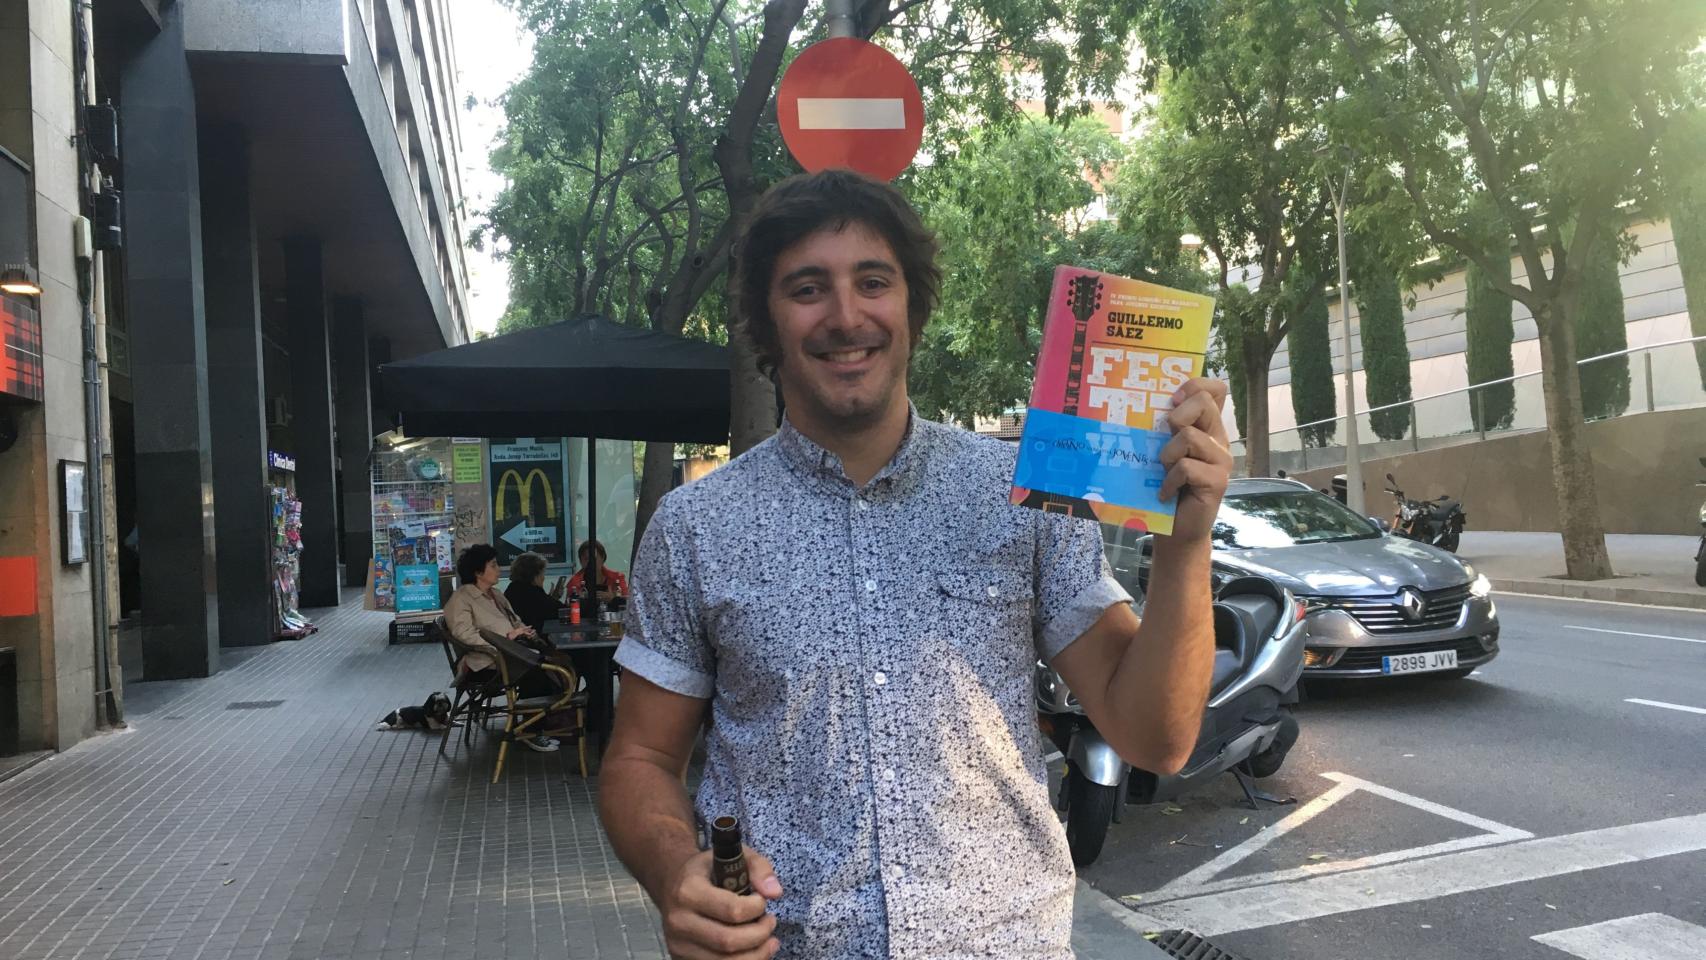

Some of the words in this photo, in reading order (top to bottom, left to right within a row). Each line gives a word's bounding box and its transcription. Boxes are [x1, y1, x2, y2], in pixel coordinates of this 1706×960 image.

[1108, 312, 1184, 330] GUILLERMO
[1087, 346, 1193, 393] FES
[1392, 655, 1426, 672] 2899
[1431, 652, 1454, 668] JVV
